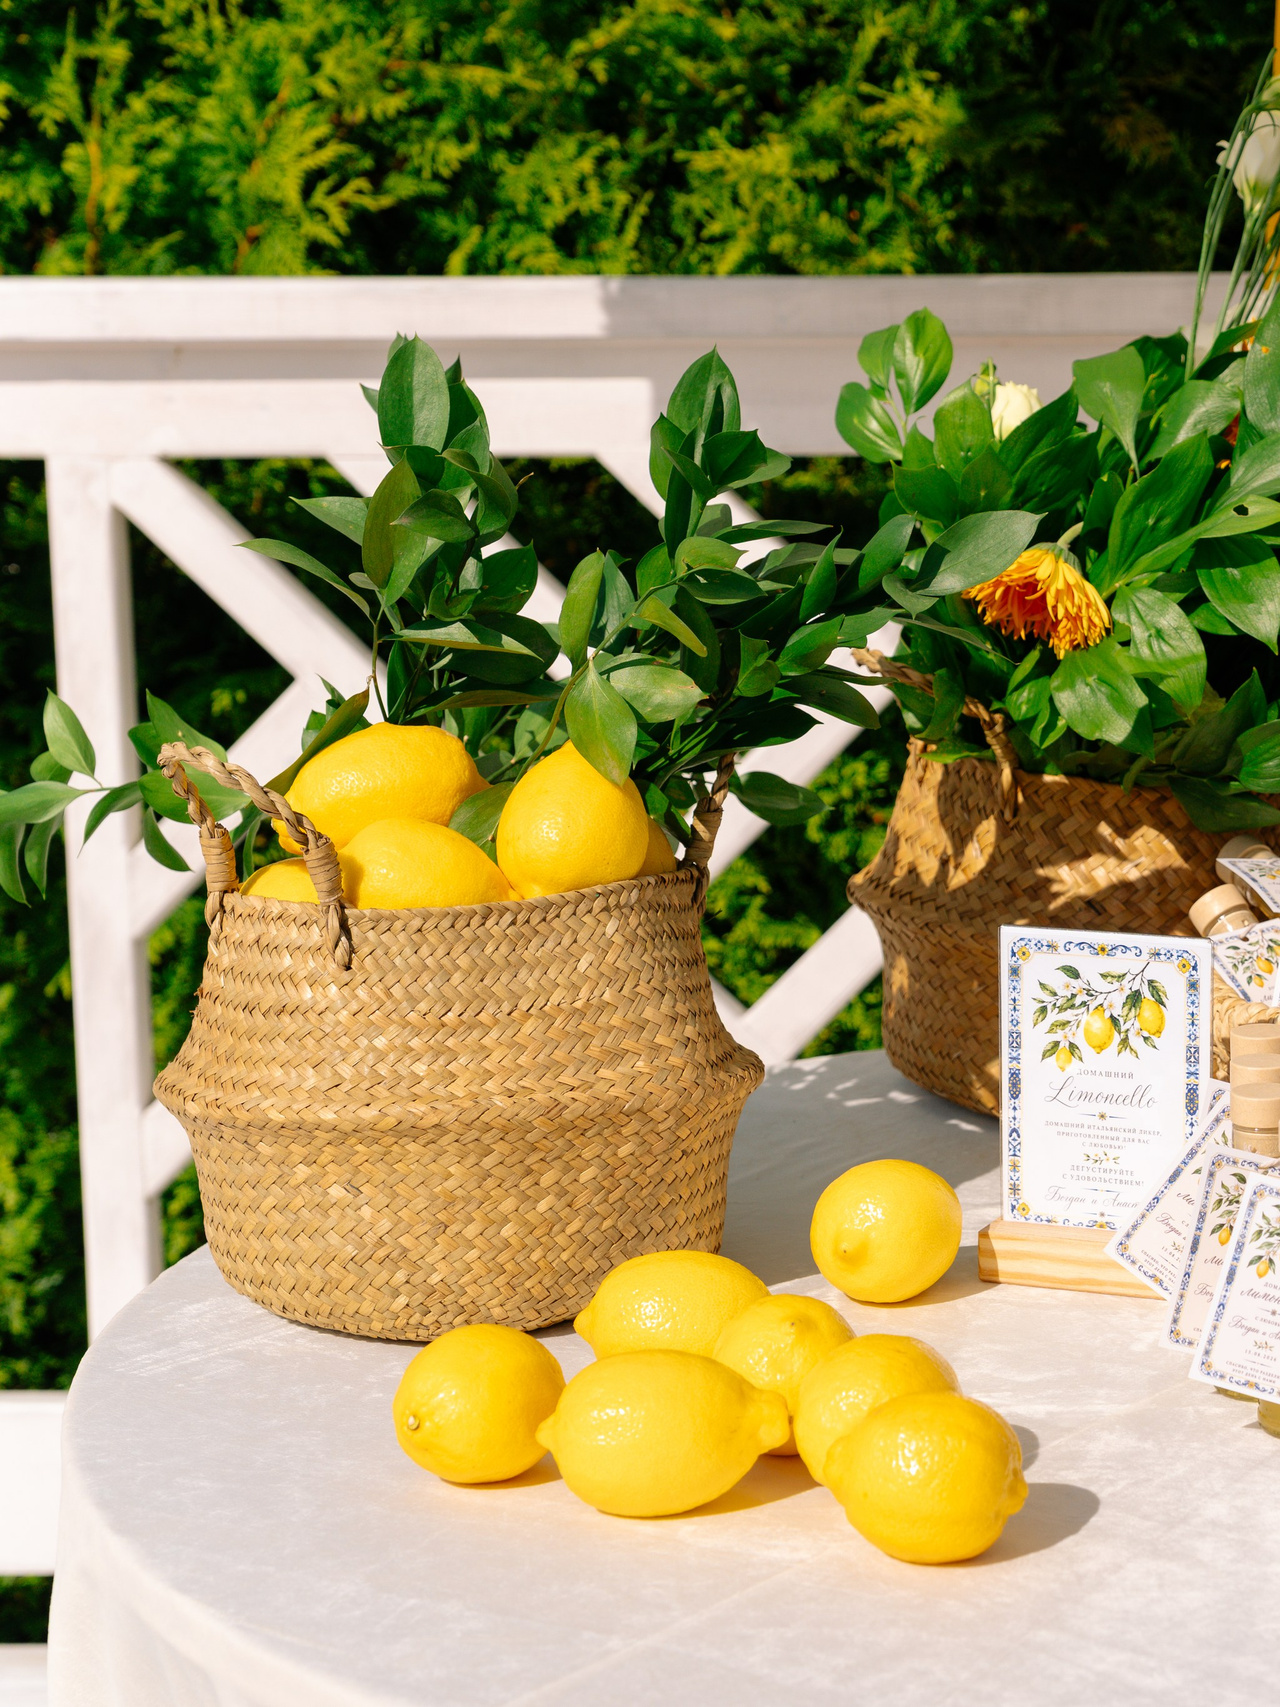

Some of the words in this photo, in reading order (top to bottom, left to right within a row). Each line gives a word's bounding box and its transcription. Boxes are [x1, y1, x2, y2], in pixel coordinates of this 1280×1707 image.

[1077, 1069, 1134, 1080] ДОМАШНИЙ
[1044, 1076, 1158, 1109] Limoncello
[1045, 1121, 1085, 1129] ДОМАШНИЙ
[1088, 1124, 1137, 1134] ИТАЛЬЯНСКИЙ
[1057, 1131, 1119, 1141] ПРИГОТОВЛЕННЫЙ
[1070, 1164, 1134, 1176] ДЕГУСТИРУЙТЕ
[1070, 1173, 1144, 1186] УДОВОЛЬСТВИЕМ!
[1045, 1186, 1086, 1211] Богдан
[1102, 1193, 1140, 1209] Анаст
[1156, 1212, 1182, 1237] Богдан
[1228, 1315, 1260, 1341] Богдан
